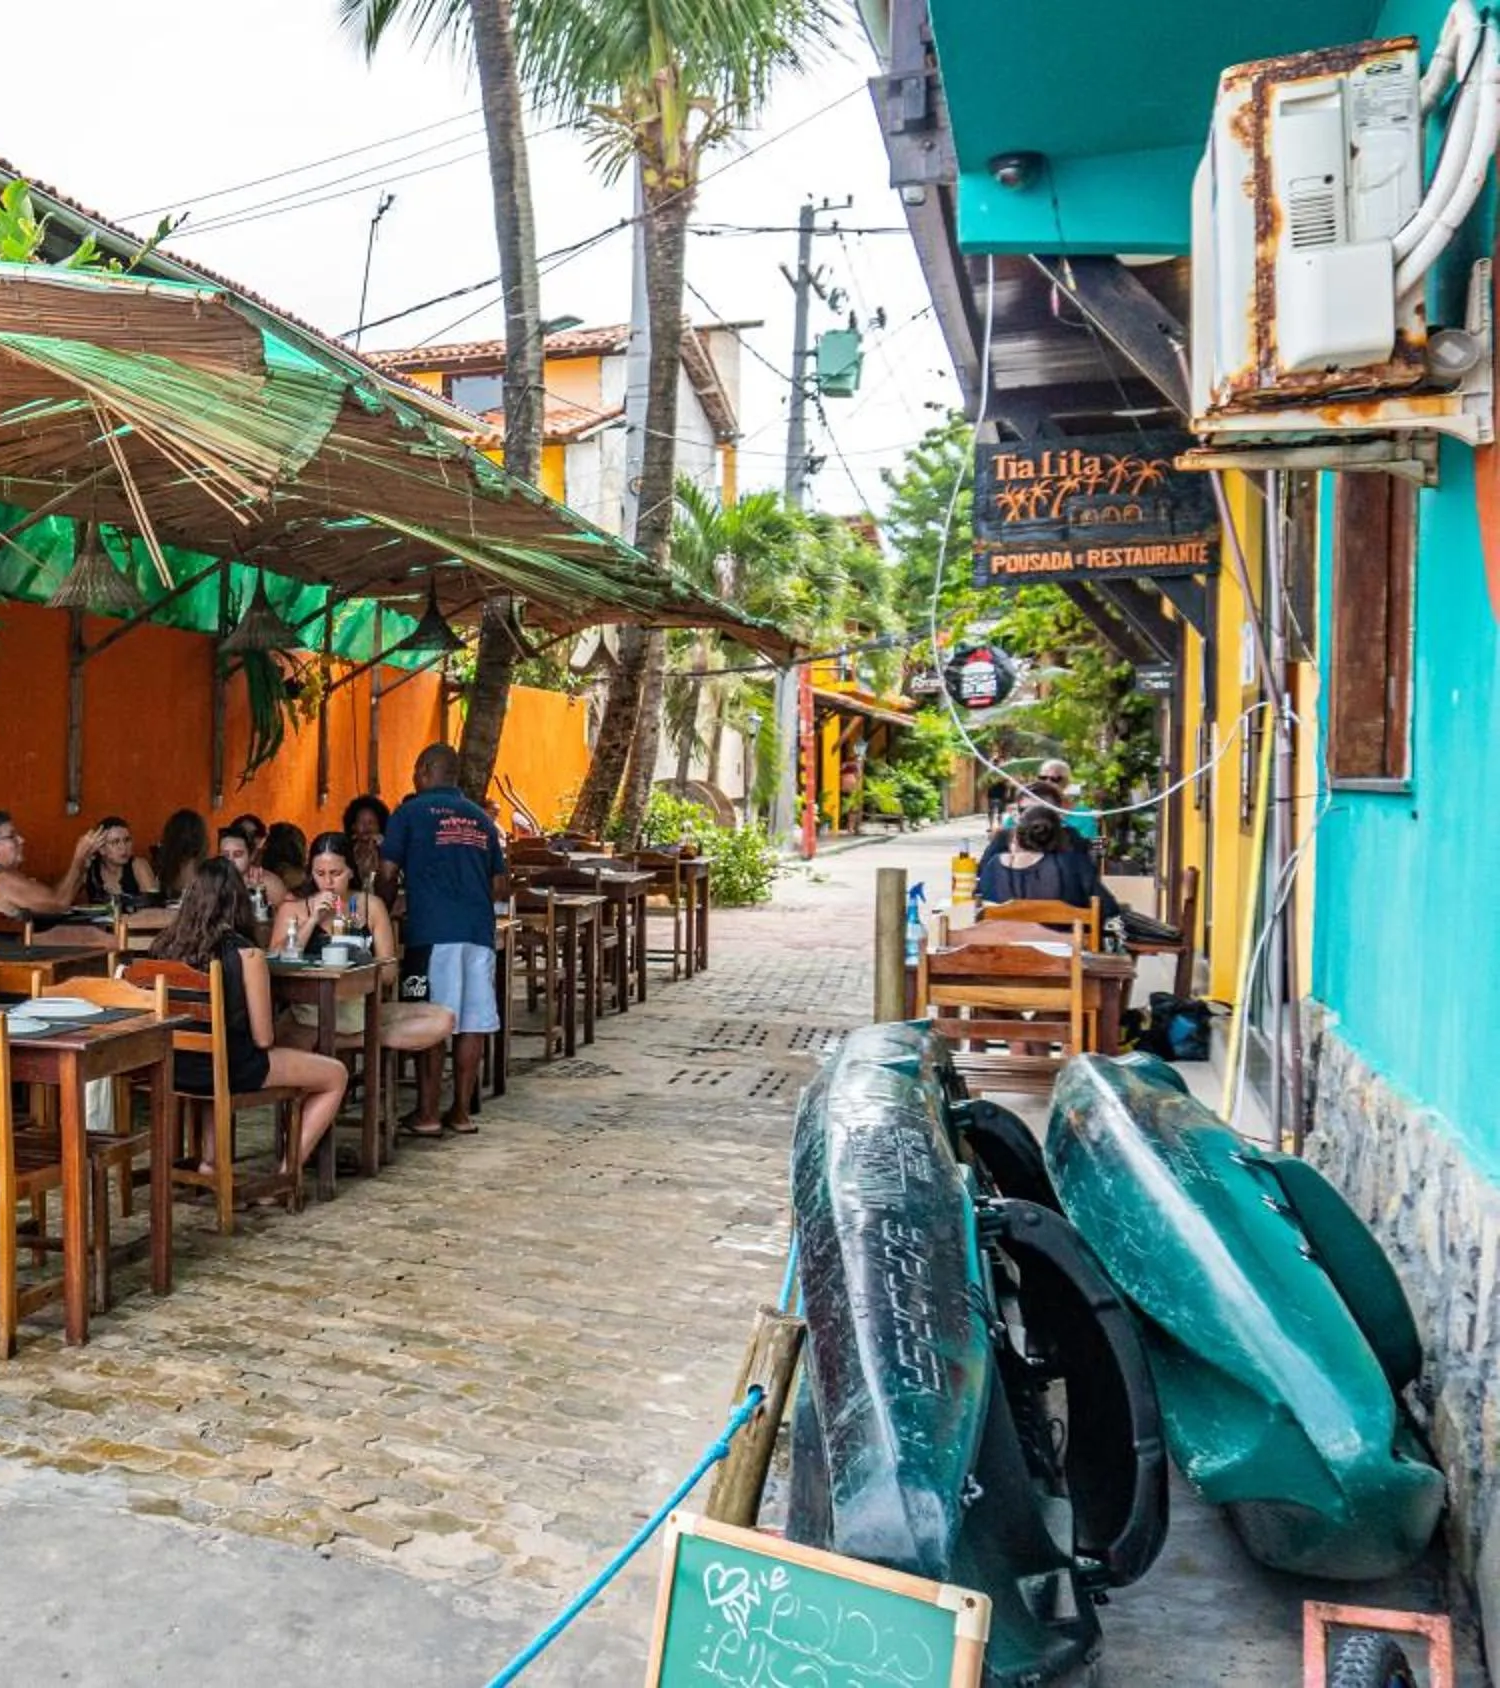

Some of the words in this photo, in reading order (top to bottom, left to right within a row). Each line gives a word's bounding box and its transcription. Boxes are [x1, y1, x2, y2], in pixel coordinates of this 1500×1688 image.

[992, 453, 1036, 481] Tia
[1041, 449, 1102, 477] Lita
[991, 551, 1074, 574] POUSADA
[1086, 543, 1209, 569] RESTAURANTE
